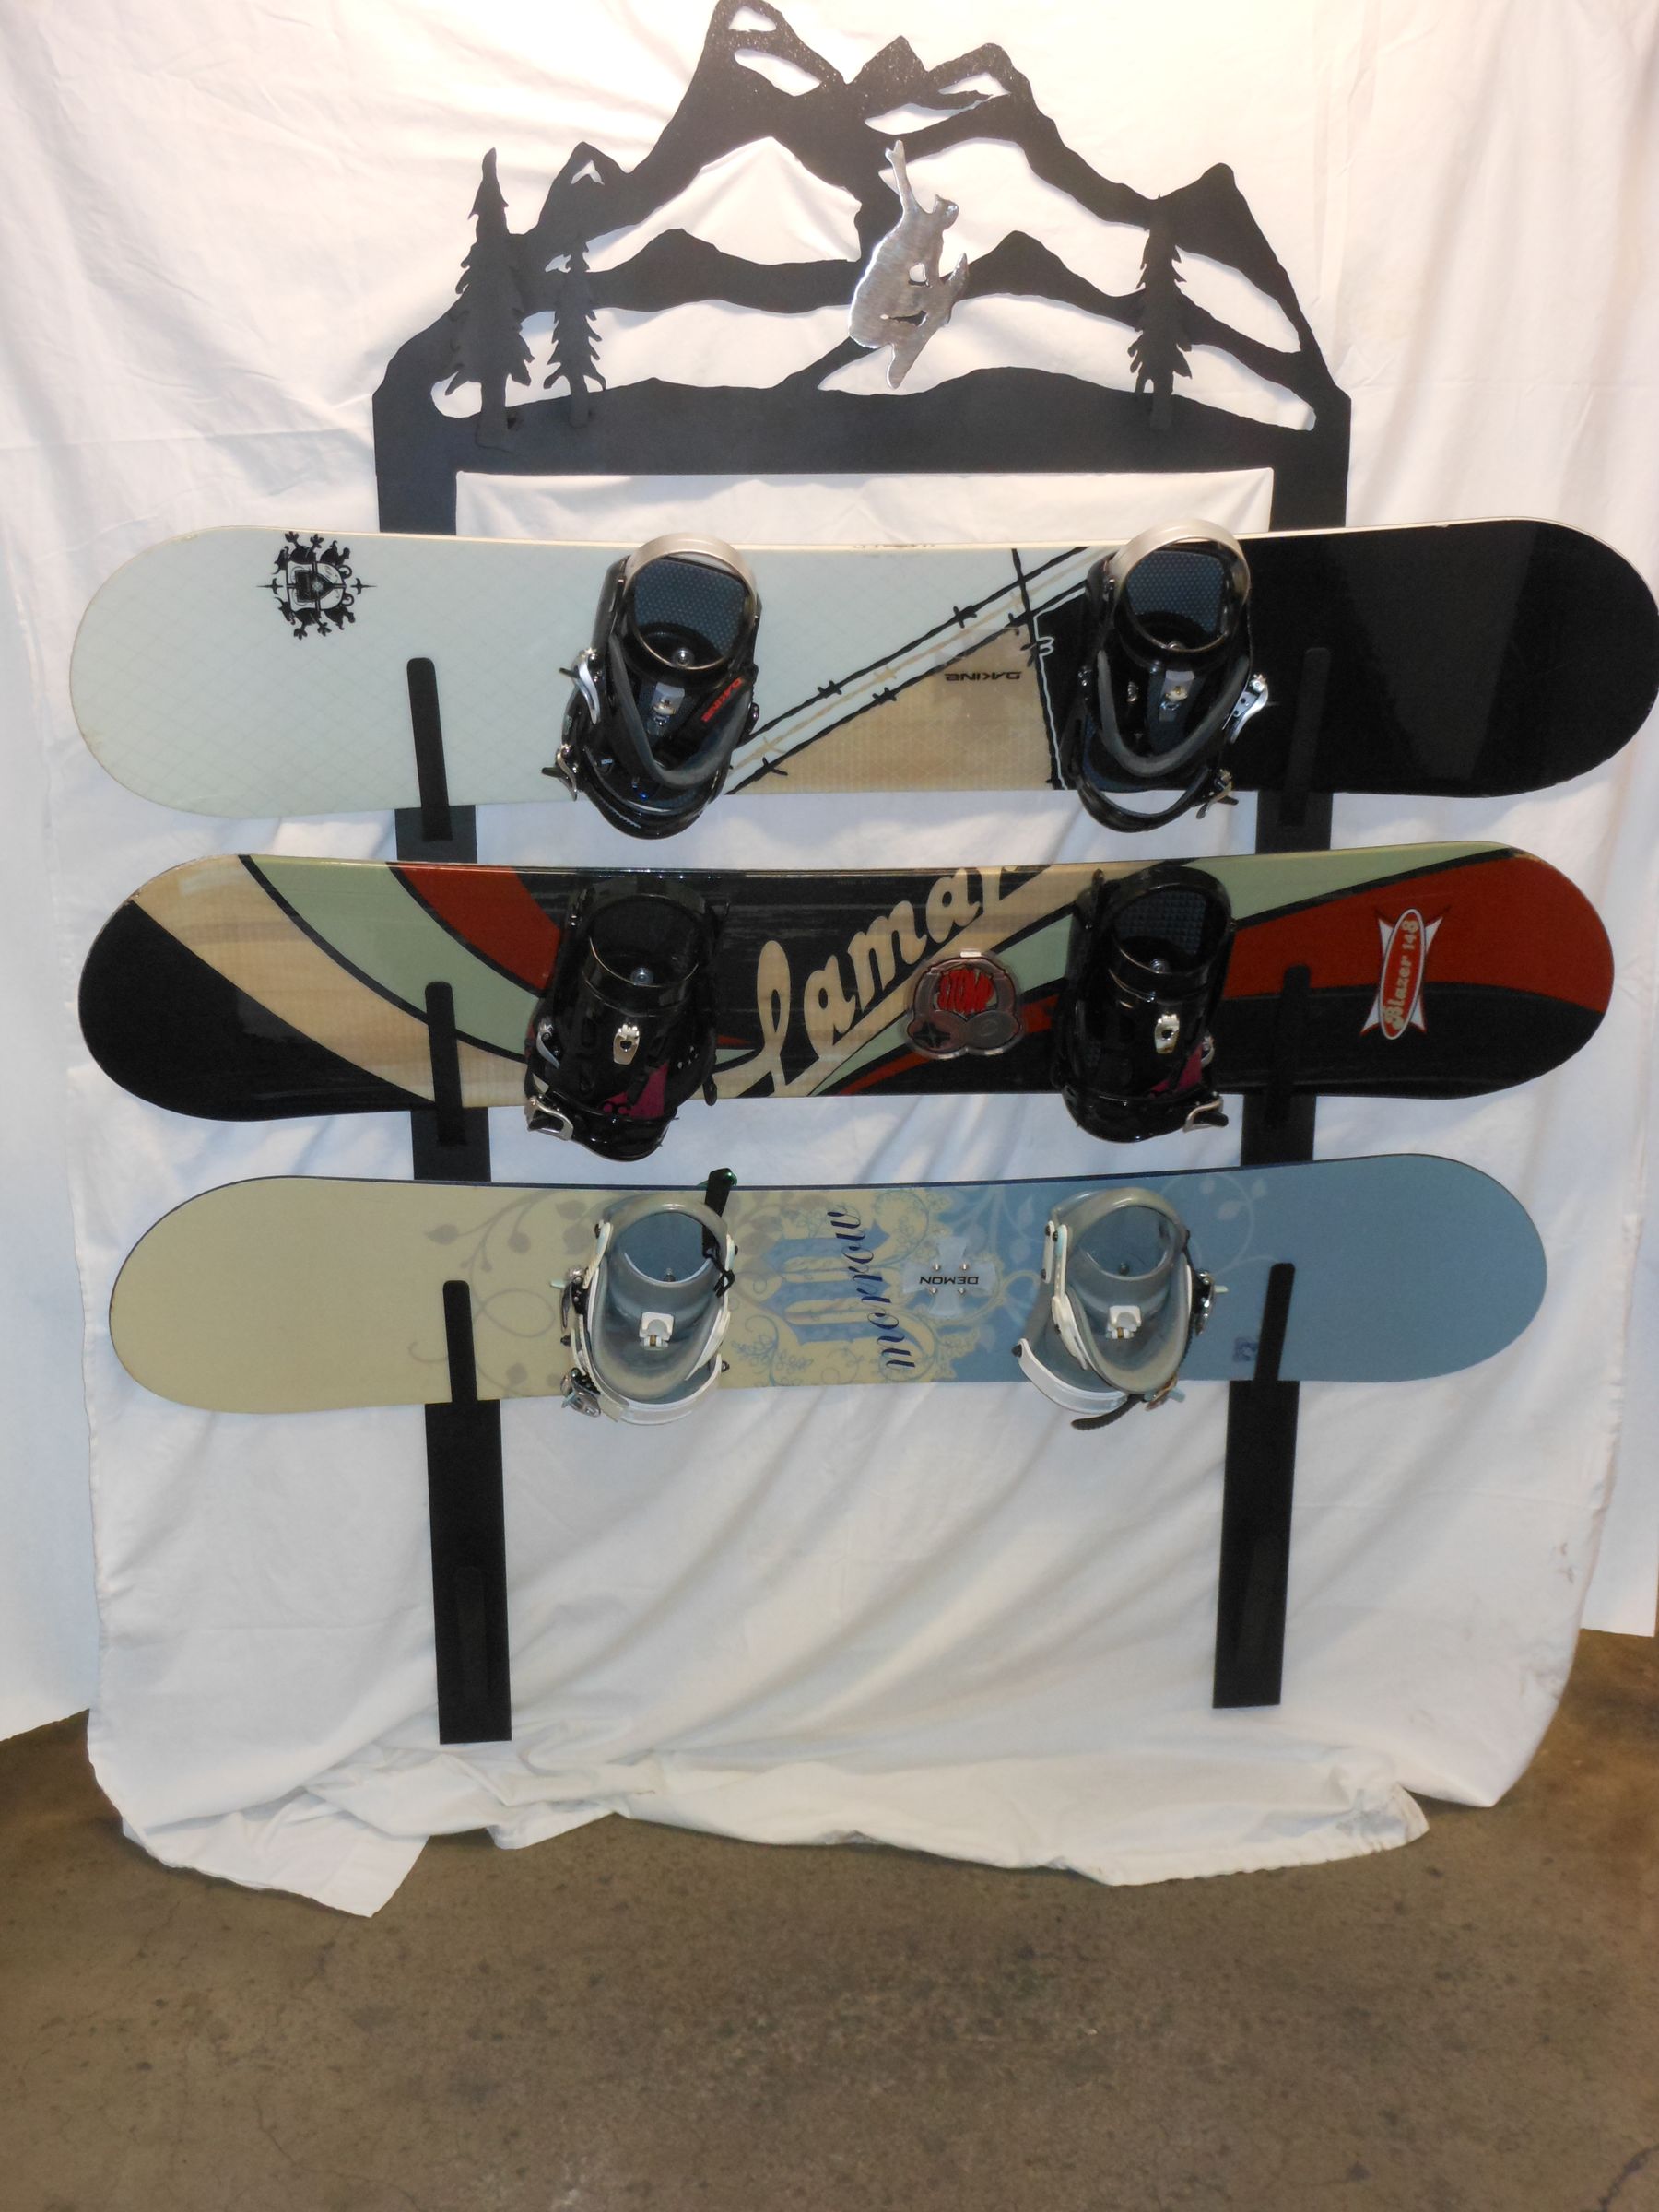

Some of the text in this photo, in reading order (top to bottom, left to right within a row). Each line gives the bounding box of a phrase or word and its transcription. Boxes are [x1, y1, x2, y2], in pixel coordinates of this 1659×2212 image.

[944, 671, 1022, 682] DAKINE
[1382, 955, 1412, 1030] Blazer
[919, 1276, 979, 1286] DEMON
